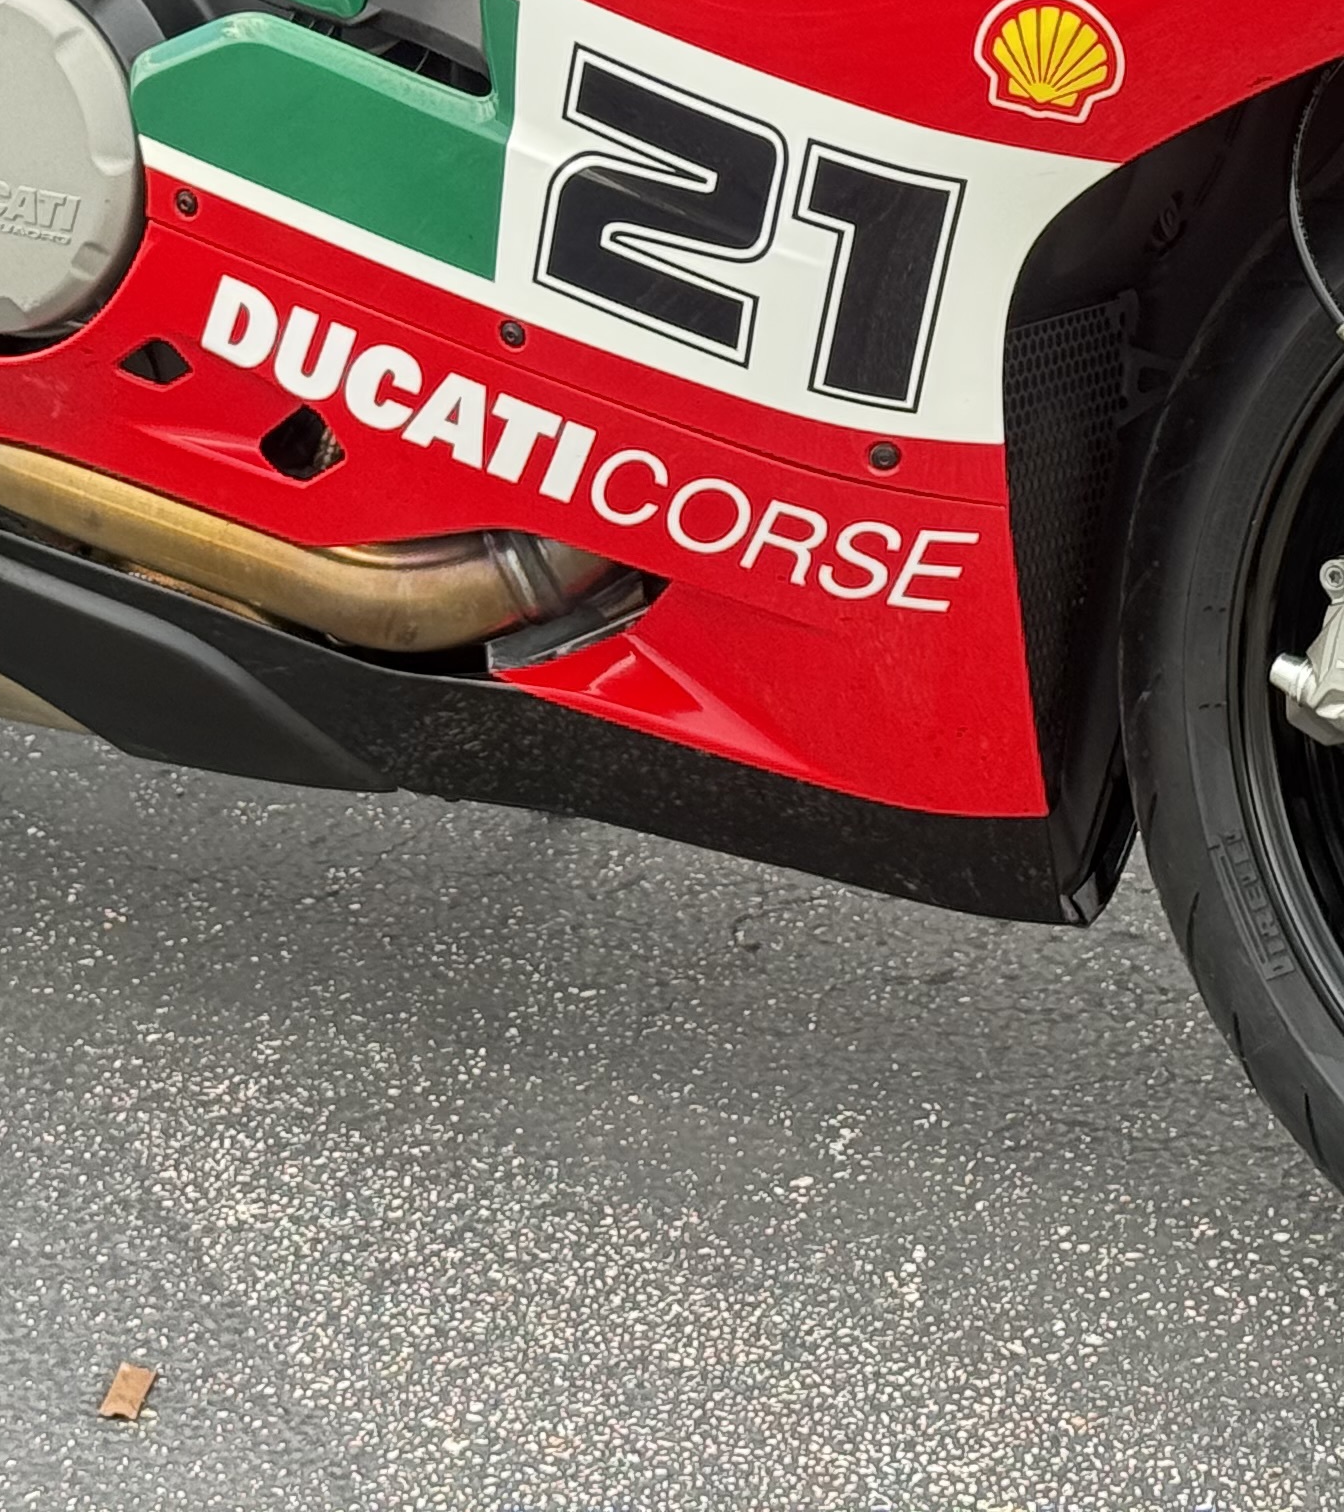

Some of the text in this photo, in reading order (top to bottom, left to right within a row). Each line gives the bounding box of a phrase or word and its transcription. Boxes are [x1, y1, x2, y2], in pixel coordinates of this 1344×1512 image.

[532, 41, 968, 414] 21
[200, 273, 981, 614] DUCATI CORSE
